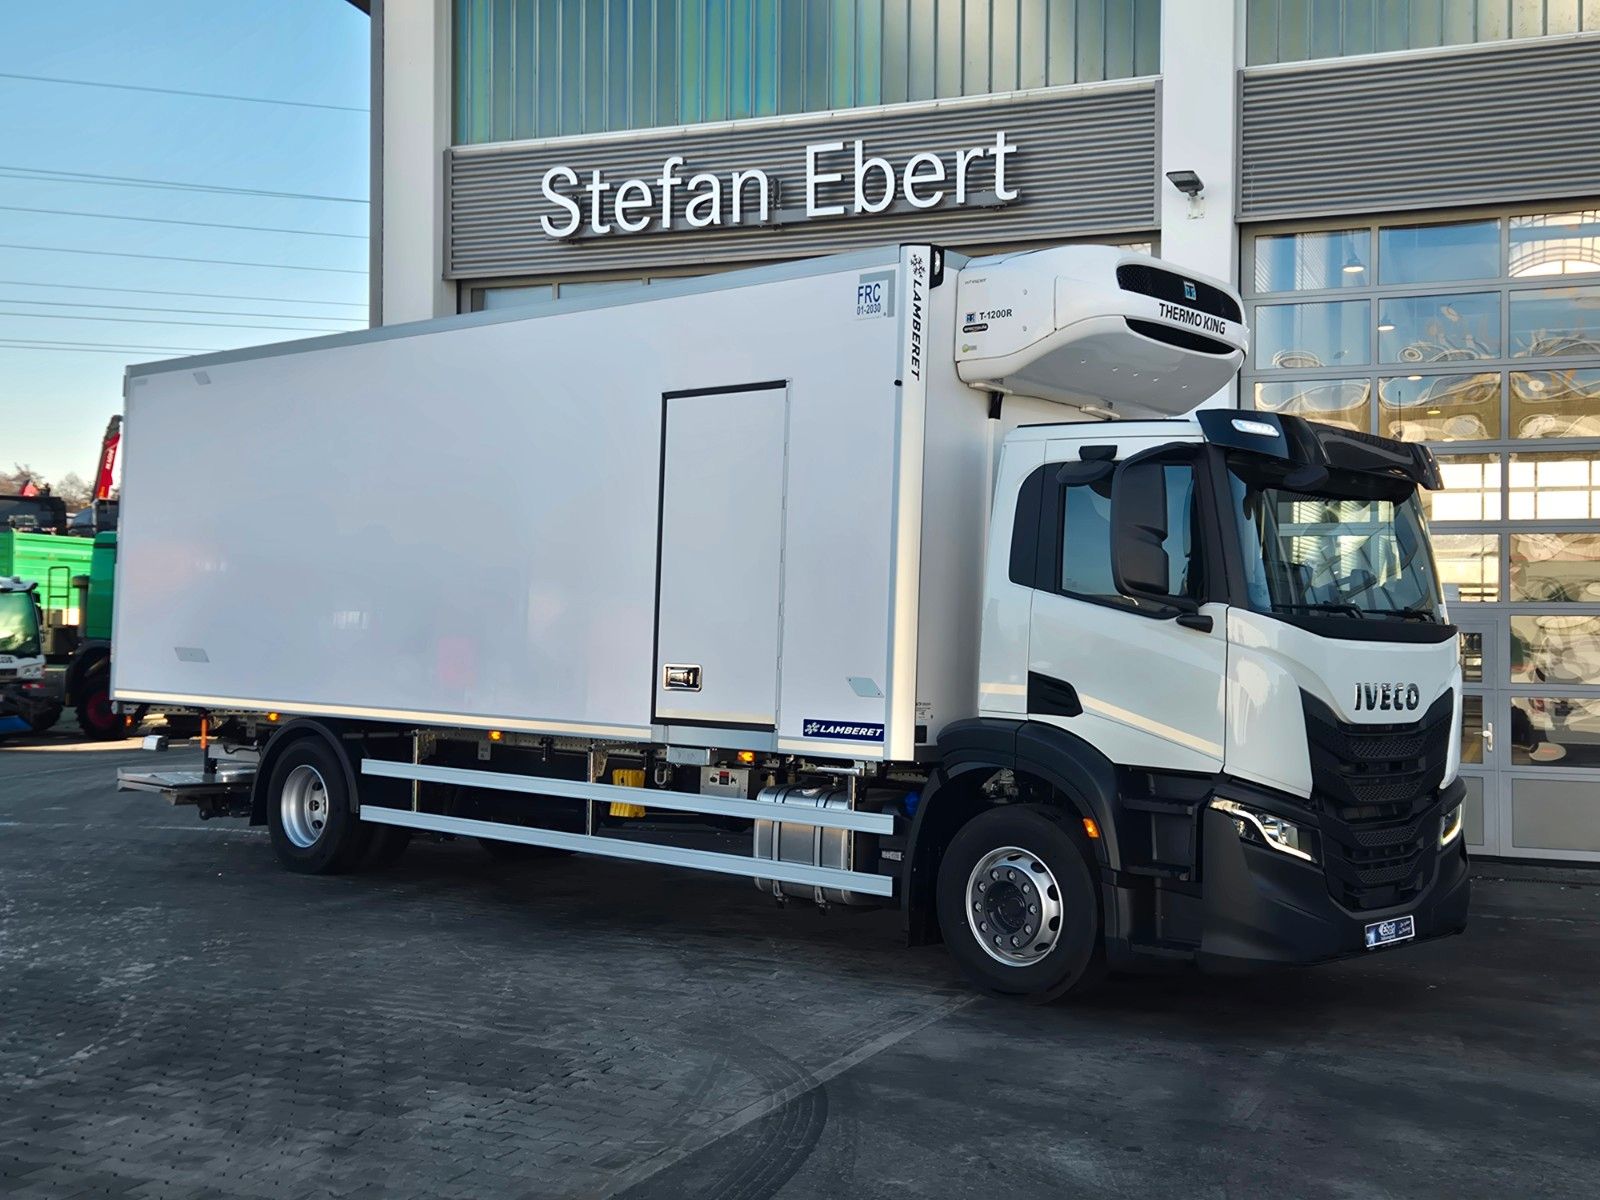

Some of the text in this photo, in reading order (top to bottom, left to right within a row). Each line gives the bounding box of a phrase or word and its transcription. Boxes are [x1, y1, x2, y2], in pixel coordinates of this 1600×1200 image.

[540, 131, 1018, 238] Stefan Ebert
[857, 283, 881, 305] FRC
[856, 302, 881, 316] 01-2030
[979, 309, 1013, 321] T-1200R
[1159, 303, 1226, 335] THERMO KING
[911, 278, 922, 381] LAMBERET
[1354, 682, 1420, 711] IVECO
[820, 725, 884, 737] LAMBERET
